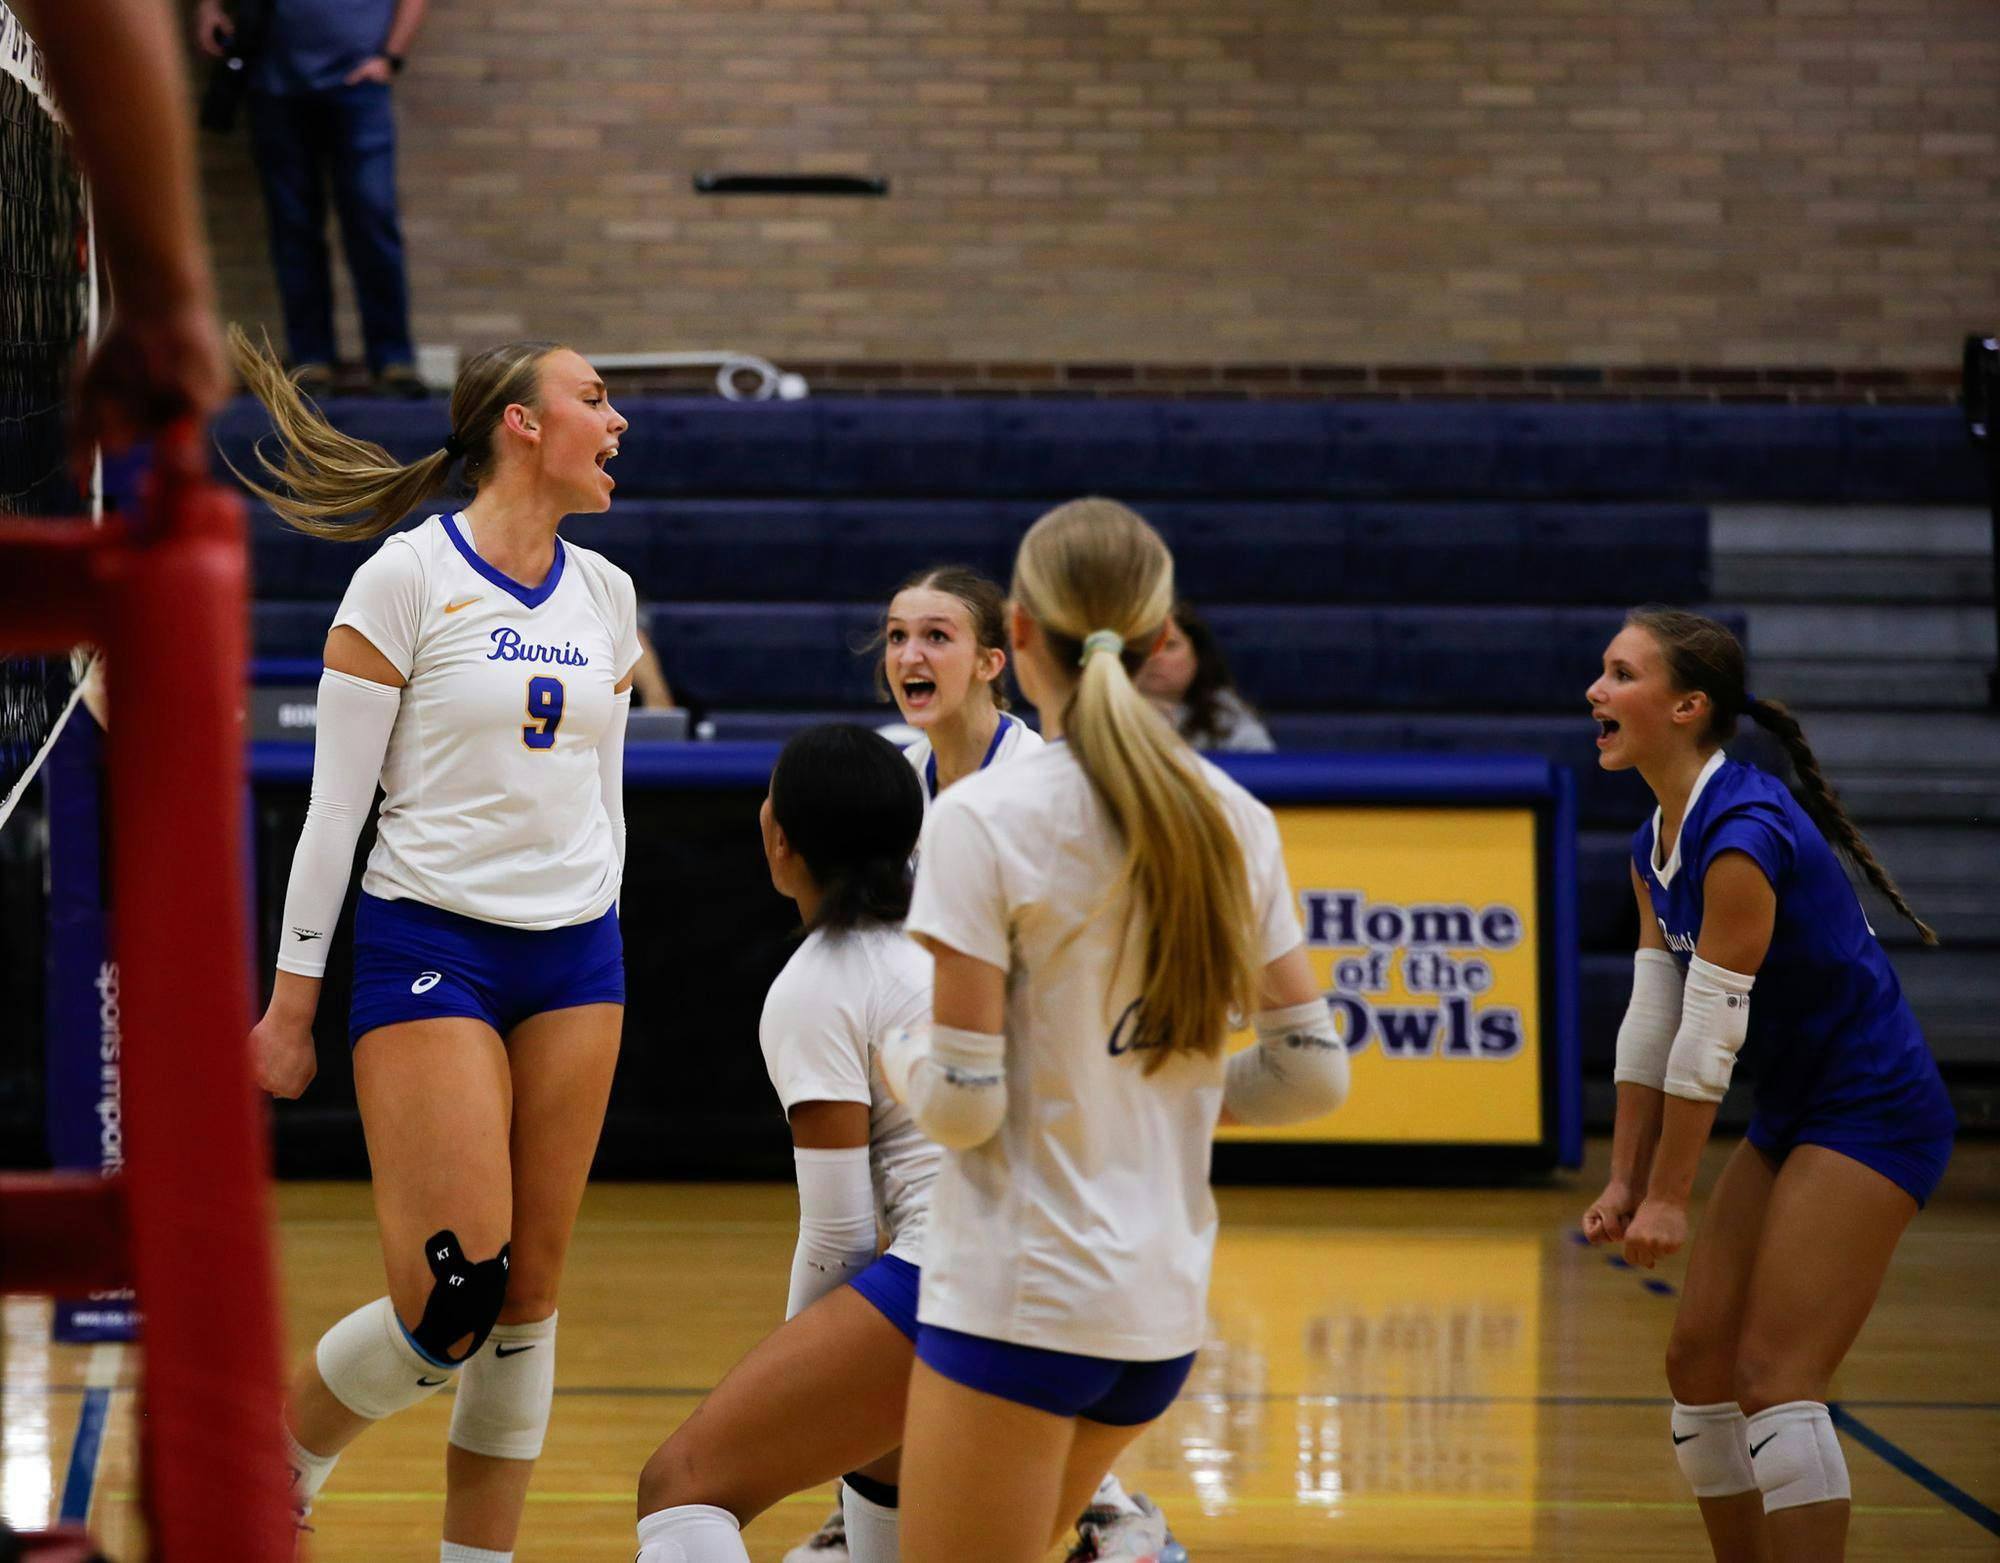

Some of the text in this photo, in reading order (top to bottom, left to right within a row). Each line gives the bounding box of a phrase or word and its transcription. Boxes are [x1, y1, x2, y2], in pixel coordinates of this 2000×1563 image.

[486, 627, 589, 666] Burris
[523, 674, 565, 752] 9
[1303, 891, 1522, 947] Home
[1335, 950, 1490, 991] of the
[436, 1247, 449, 1260] KT
[449, 1274, 464, 1286] KT
